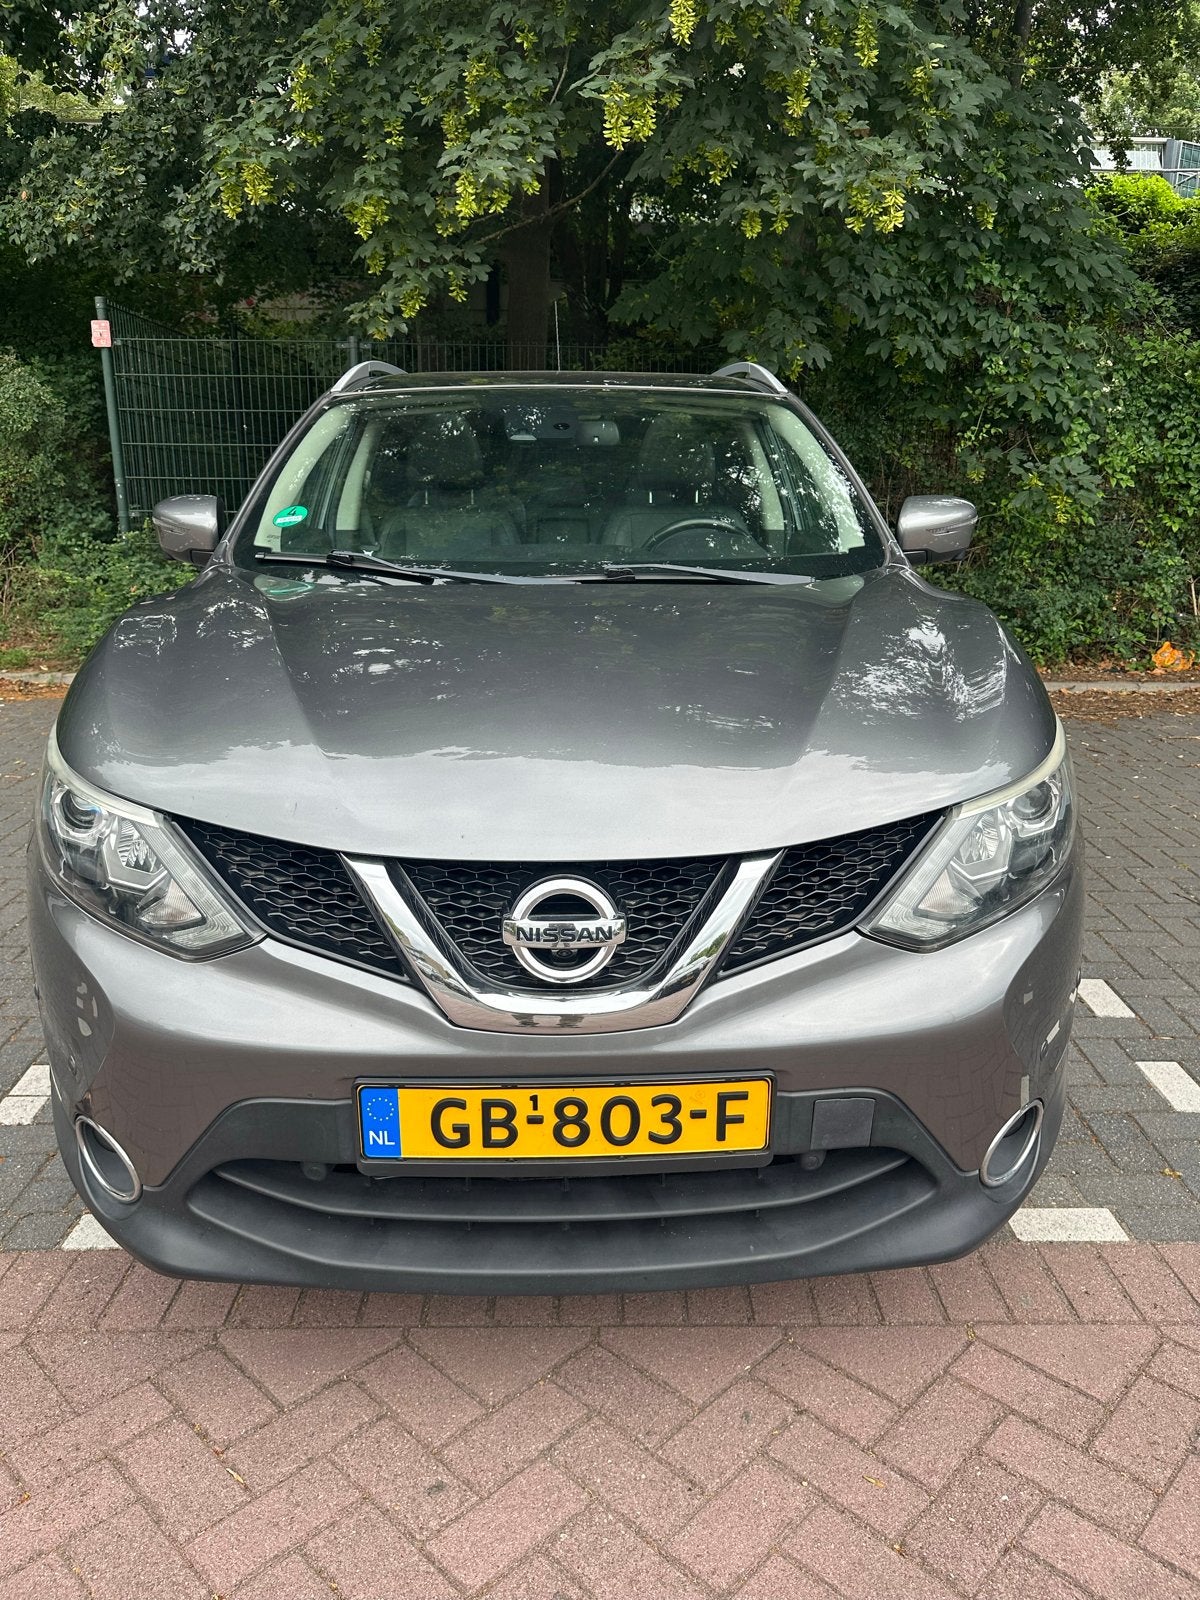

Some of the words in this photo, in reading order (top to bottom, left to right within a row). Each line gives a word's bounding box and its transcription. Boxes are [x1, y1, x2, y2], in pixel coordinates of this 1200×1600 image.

[287, 506, 297, 516] 4
[516, 926, 613, 943] NISSAN
[528, 1094, 540, 1111] 1
[430, 1091, 750, 1149] GB-803-F
[368, 1130, 396, 1146] NL
